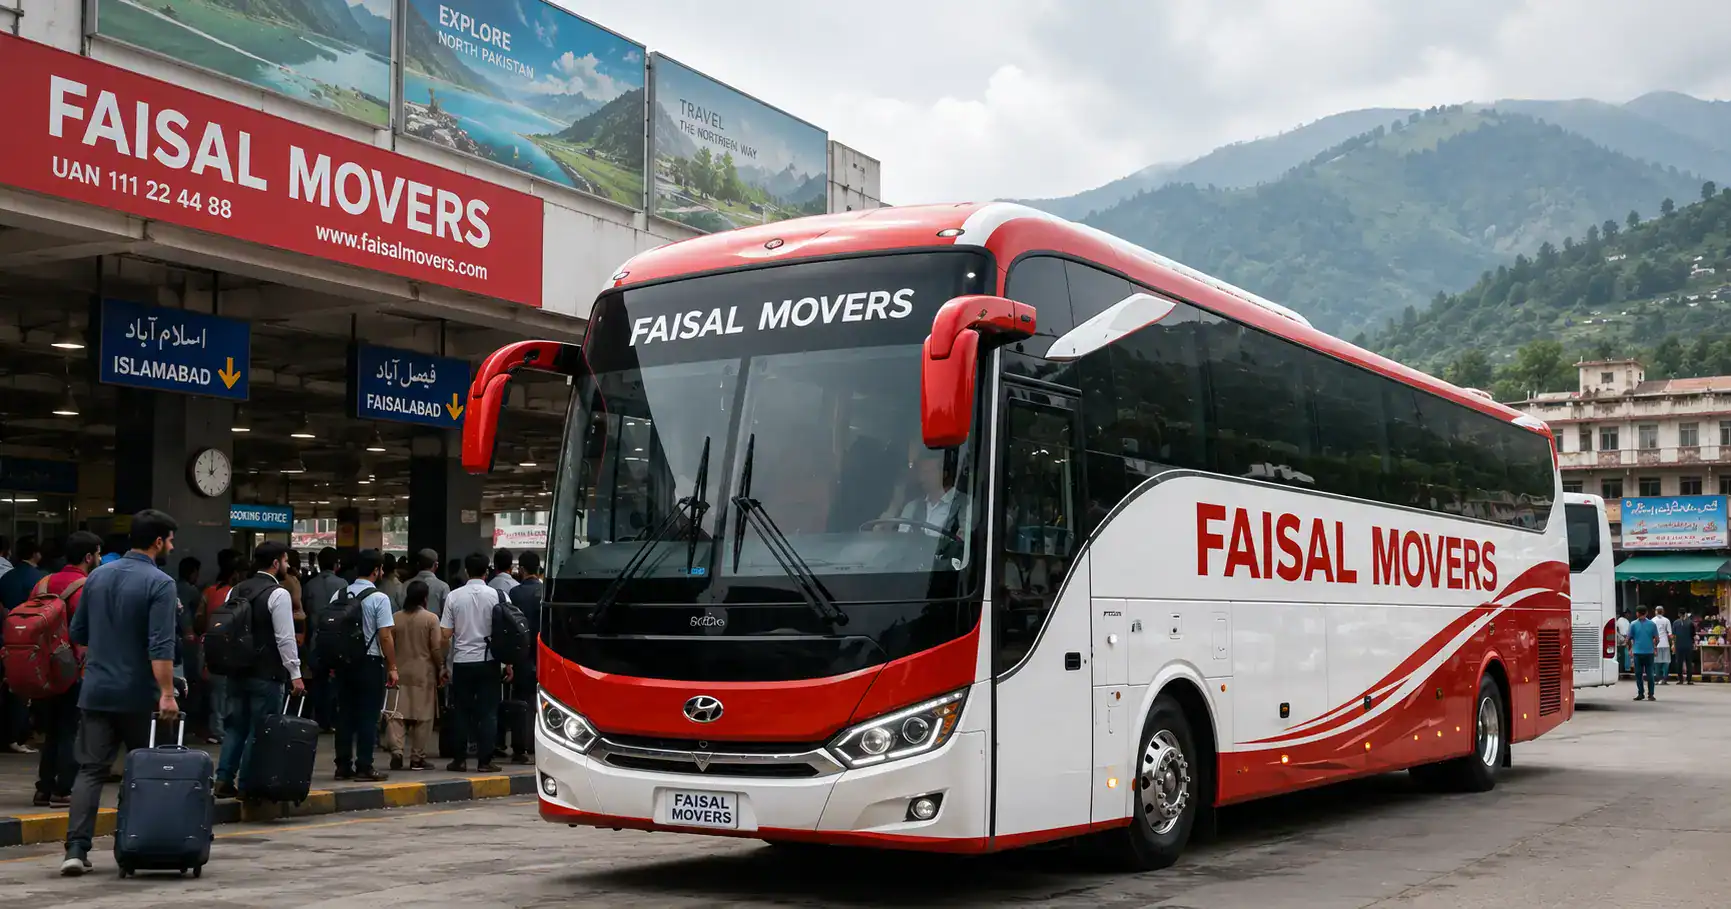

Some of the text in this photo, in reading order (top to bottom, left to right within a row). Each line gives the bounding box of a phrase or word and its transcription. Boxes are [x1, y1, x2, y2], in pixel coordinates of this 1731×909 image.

[439, 4, 511, 51] EXPLORE
[438, 30, 534, 79] NORTH PAKISTAN
[679, 98, 725, 130] TRAVEL
[679, 119, 695, 135] THE
[740, 144, 758, 160] WAY
[49, 75, 491, 248] FAISAL MOVERS
[52, 156, 232, 219] UAN 111 22 44 88
[316, 225, 488, 280] www.faisalmovers.com
[125, 316, 206, 350] اسلام آباد
[629, 289, 914, 346] FAISAL MOVERS
[114, 355, 211, 386] ISLAMABAD
[376, 358, 400, 386] آباد
[366, 393, 441, 418] FAISALABAD
[1197, 502, 1498, 591] FAISAL MOVERS
[672, 808, 732, 824] MOVERS
[675, 794, 730, 809] FAISAL
